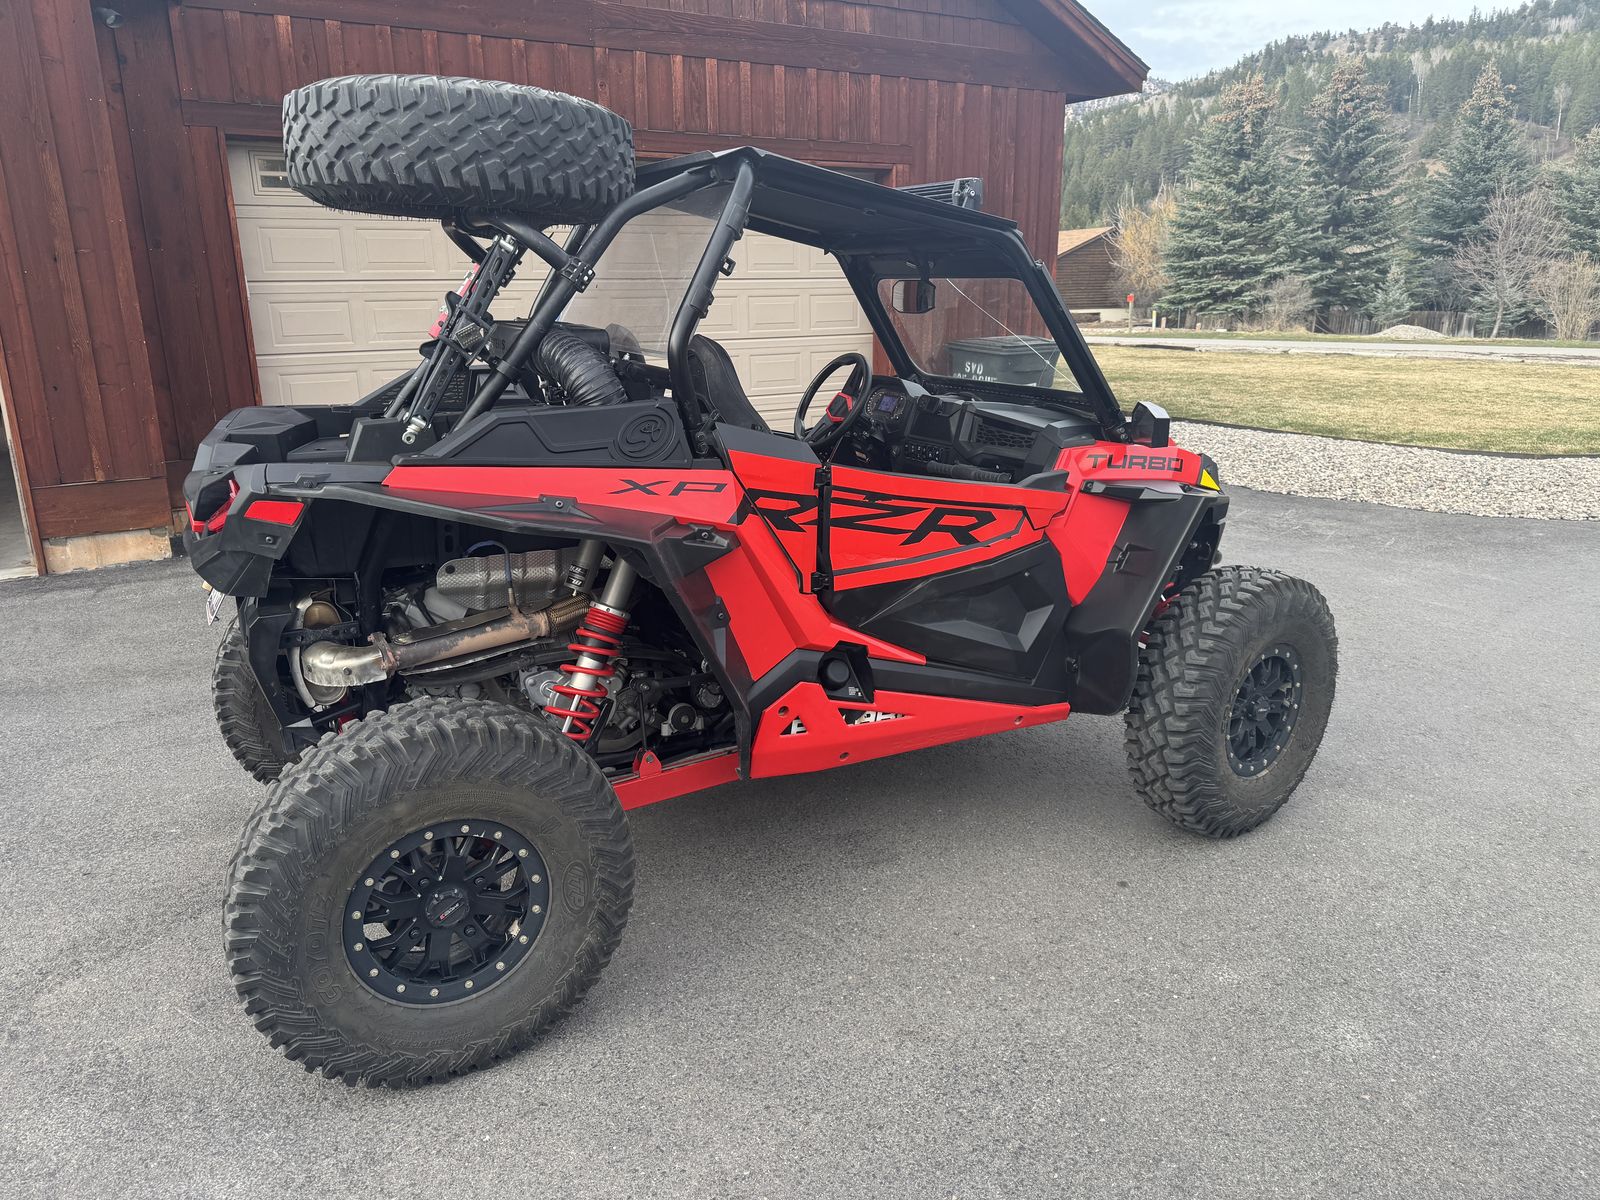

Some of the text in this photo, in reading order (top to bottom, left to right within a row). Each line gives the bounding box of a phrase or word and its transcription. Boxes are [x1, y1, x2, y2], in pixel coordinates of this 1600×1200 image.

[1087, 453, 1184, 473] TURBO
[606, 478, 728, 497] XP
[736, 487, 998, 548] RZR
